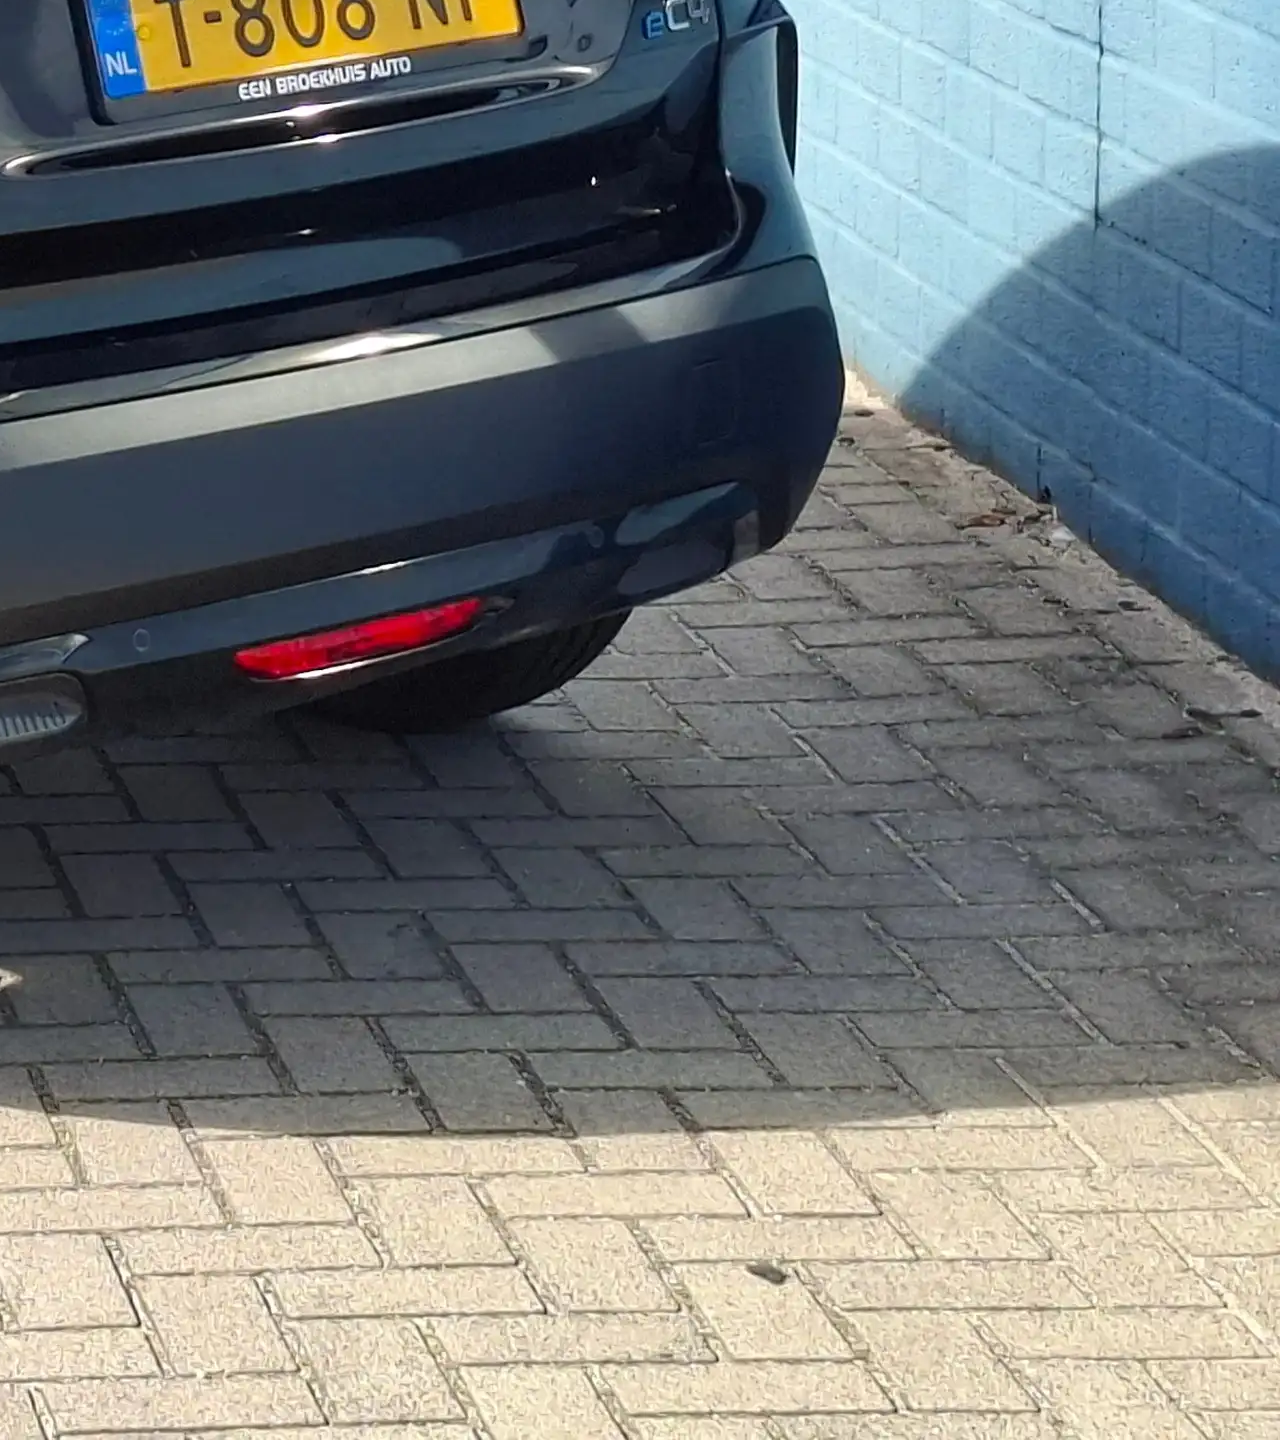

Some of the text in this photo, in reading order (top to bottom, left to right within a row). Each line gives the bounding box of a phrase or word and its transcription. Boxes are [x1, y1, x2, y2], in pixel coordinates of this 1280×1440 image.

[107, 53, 137, 76] NL
[238, 57, 411, 101] EEN BROEKHUIS AUTO
